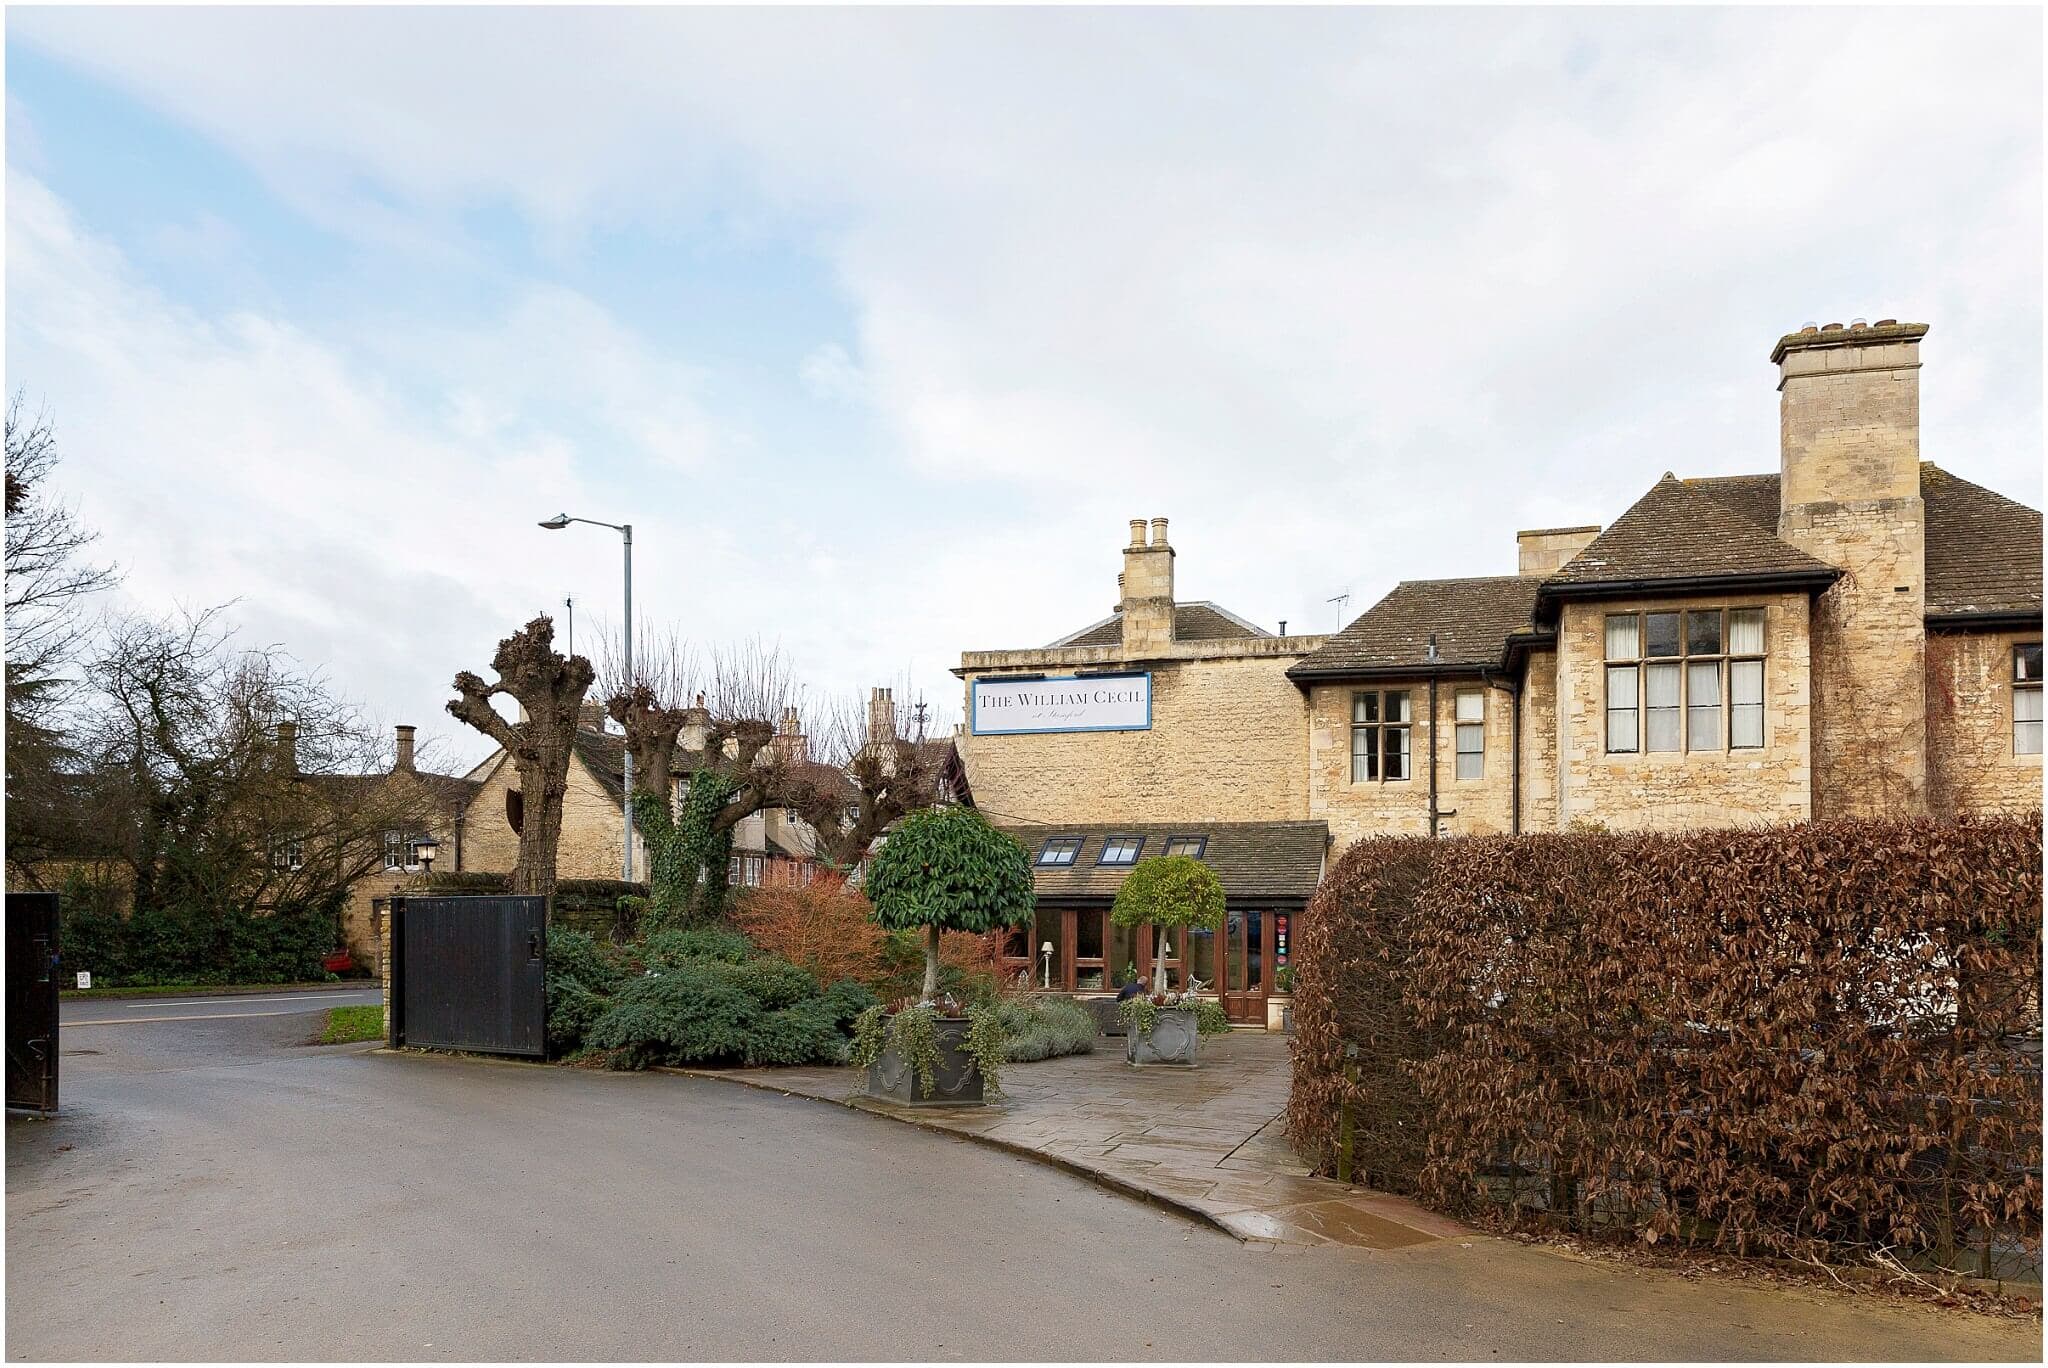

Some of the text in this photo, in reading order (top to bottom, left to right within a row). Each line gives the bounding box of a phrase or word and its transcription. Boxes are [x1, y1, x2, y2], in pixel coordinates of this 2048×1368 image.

[978, 689, 1144, 708] THE WILLIAM CECIL
